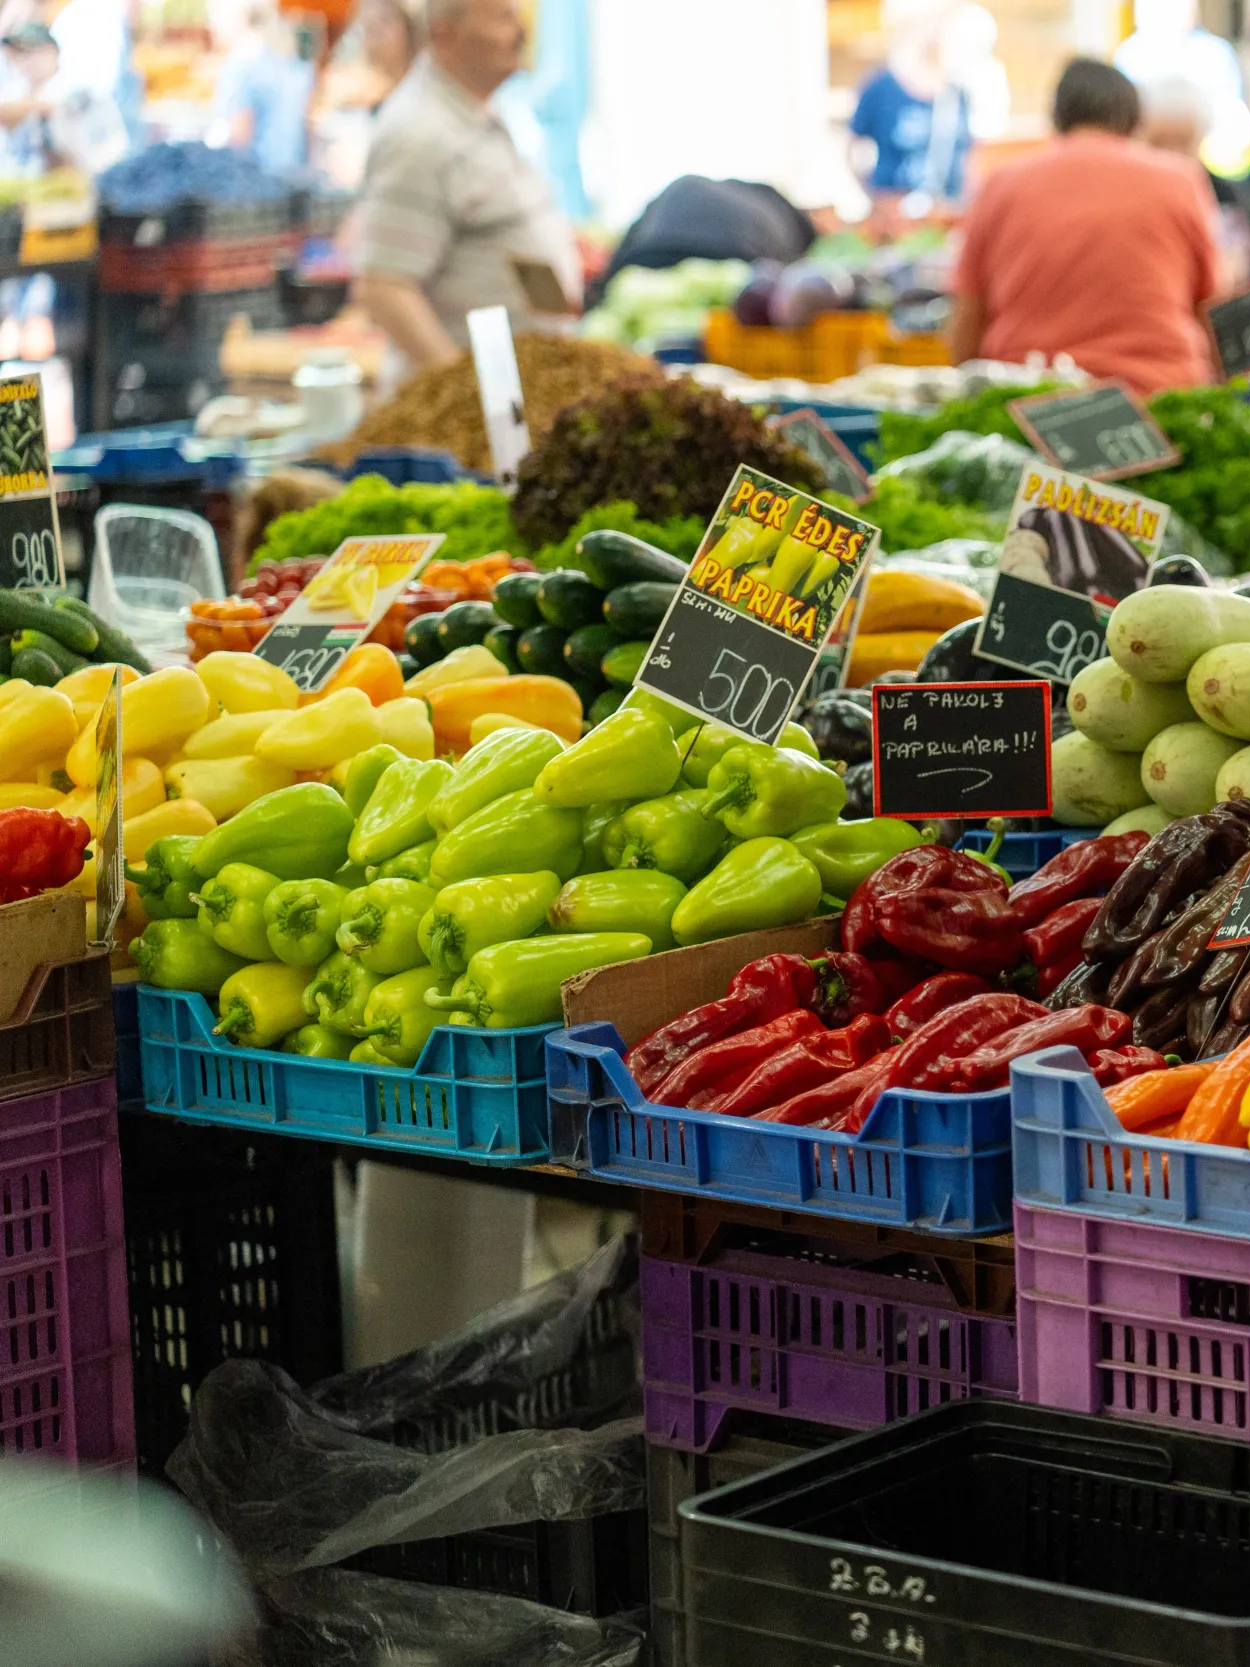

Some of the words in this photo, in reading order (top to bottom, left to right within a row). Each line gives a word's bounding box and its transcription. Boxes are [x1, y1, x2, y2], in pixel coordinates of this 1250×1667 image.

[731, 480, 789, 530] PCR
[791, 503, 865, 563] ÉDES
[1023, 473, 1160, 540] PADLIZSÁN
[12, 529, 58, 591] 980
[696, 558, 818, 641] PAPRIKA
[1028, 619, 1110, 679] 98
[699, 648, 795, 740] 500
[903, 713, 918, 731] A
